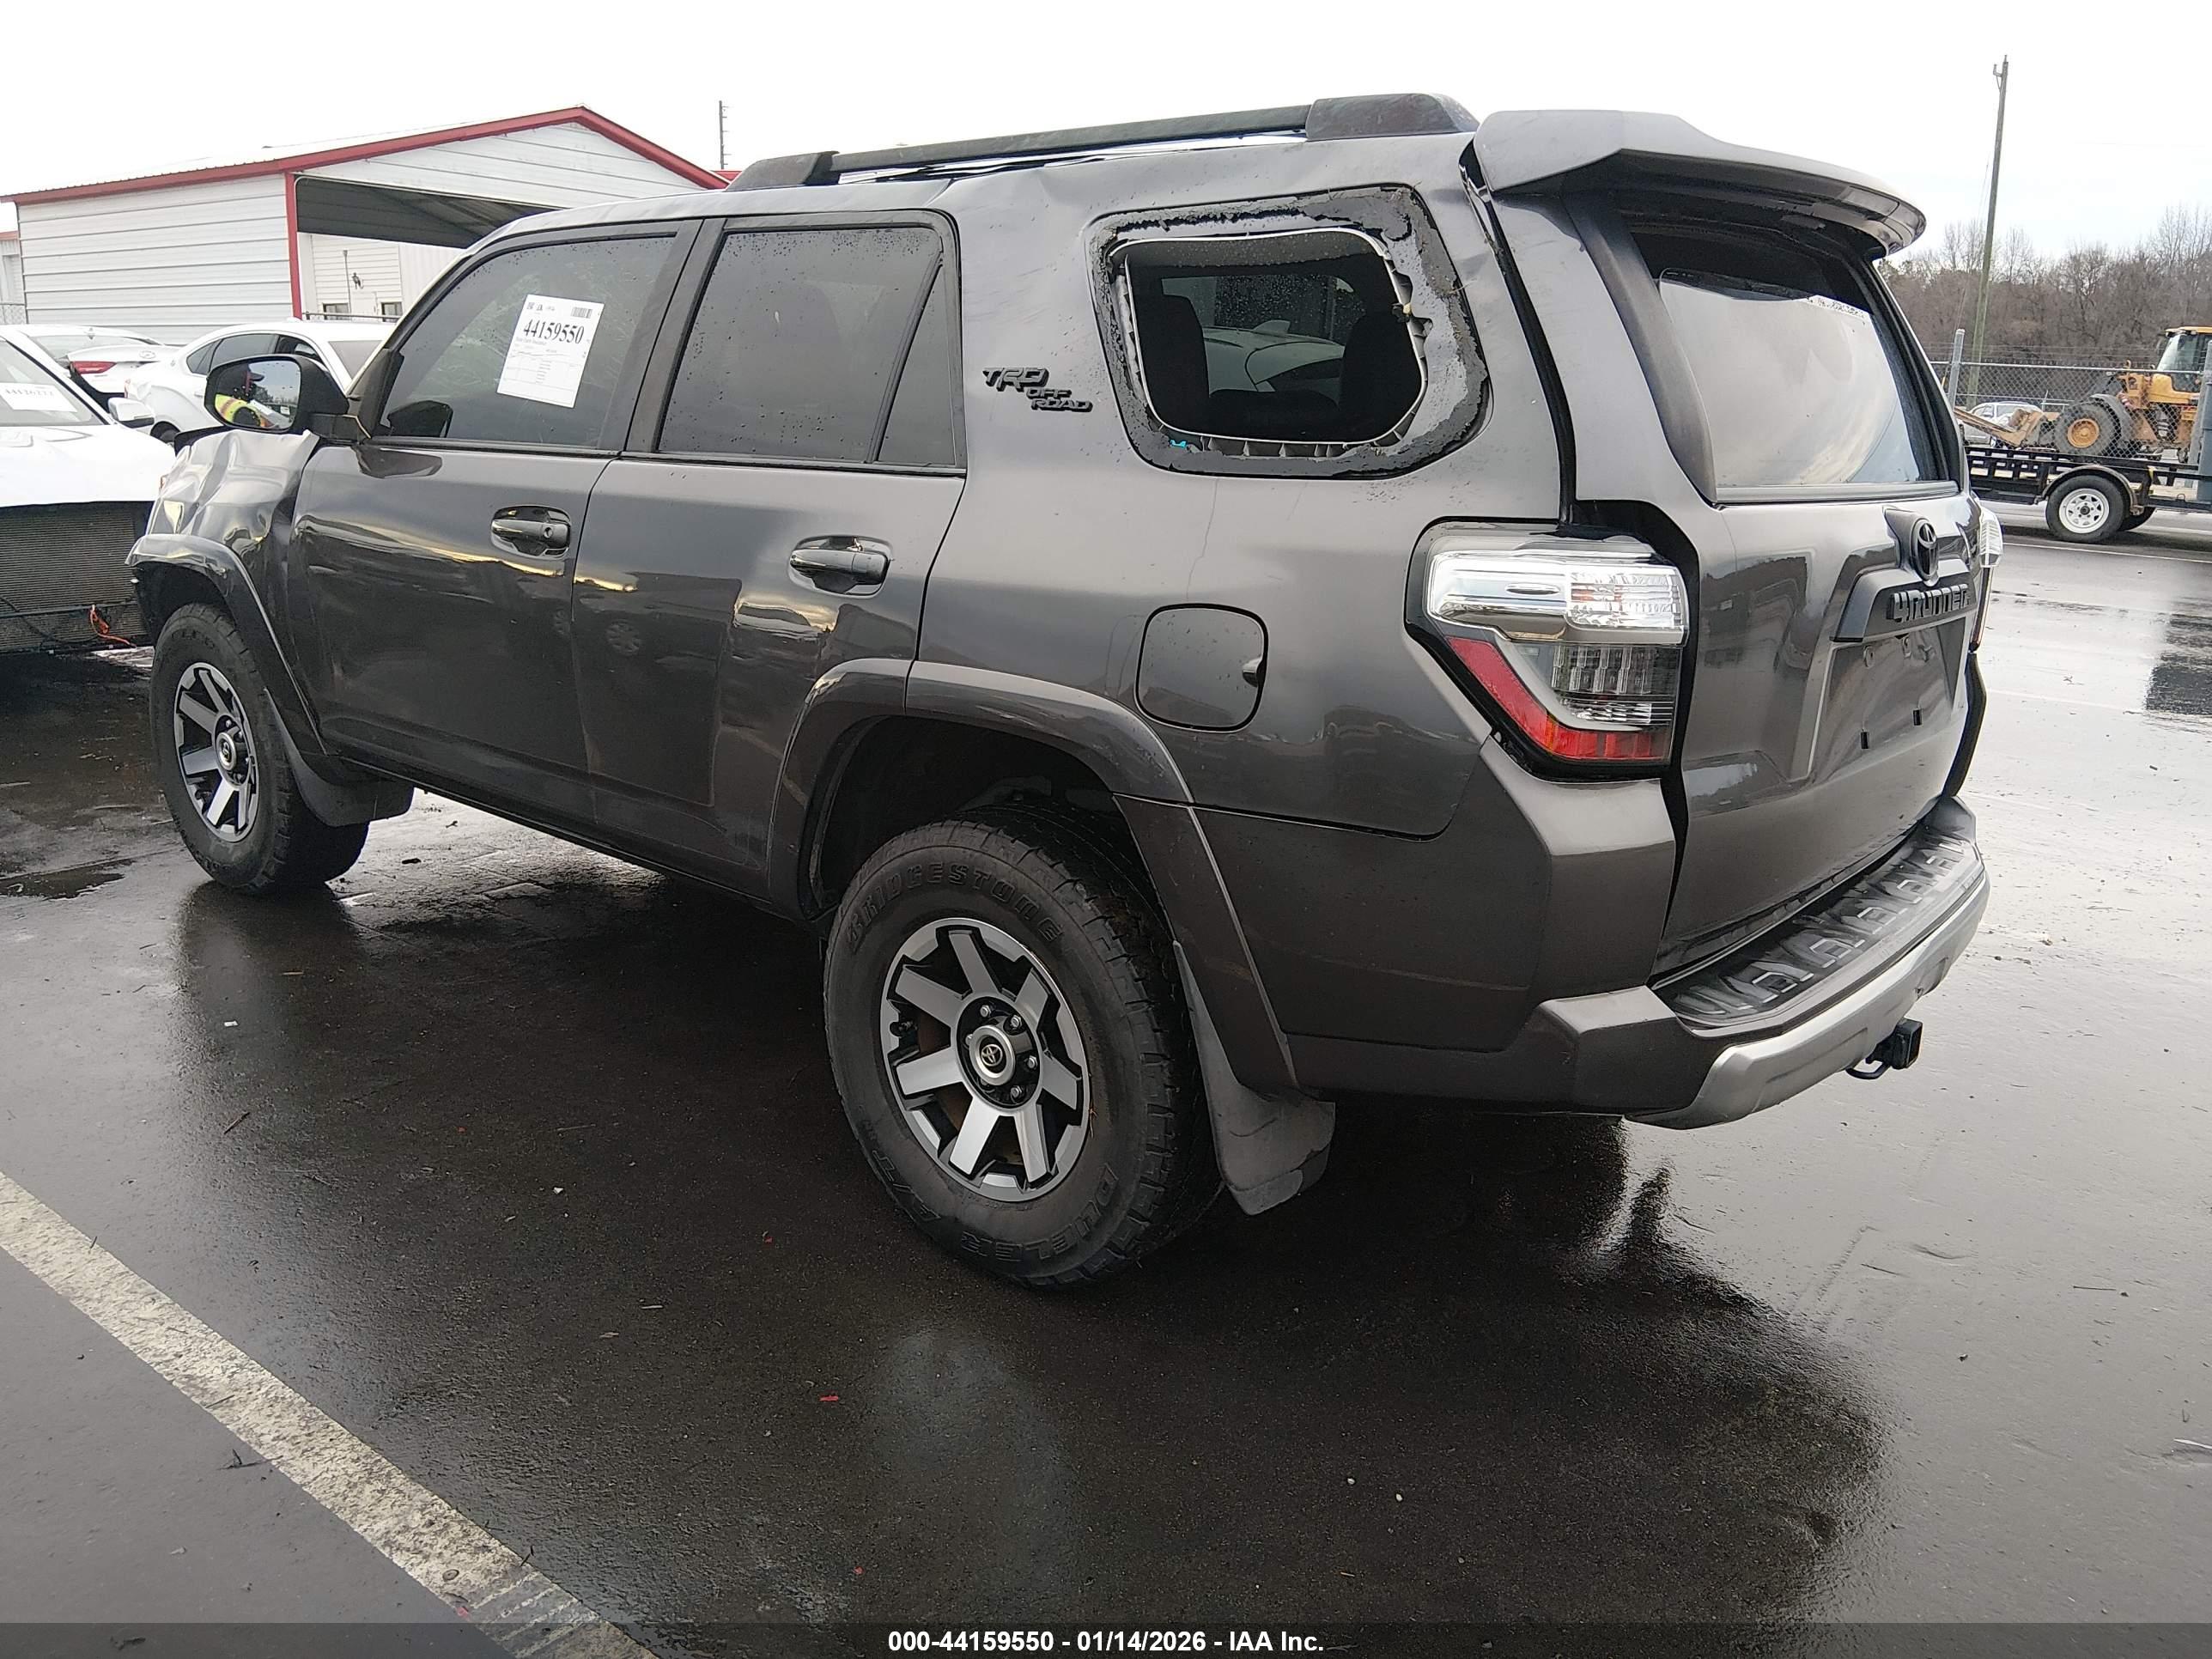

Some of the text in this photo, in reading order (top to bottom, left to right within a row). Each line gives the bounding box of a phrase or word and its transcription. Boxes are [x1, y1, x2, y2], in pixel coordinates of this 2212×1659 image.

[524, 319, 585, 344] 44159550
[982, 368, 1049, 392] TRD
[1026, 388, 1073, 398] OFF
[1031, 398, 1093, 412] ROAD
[847, 861, 1064, 951] BRIDGESTONE
